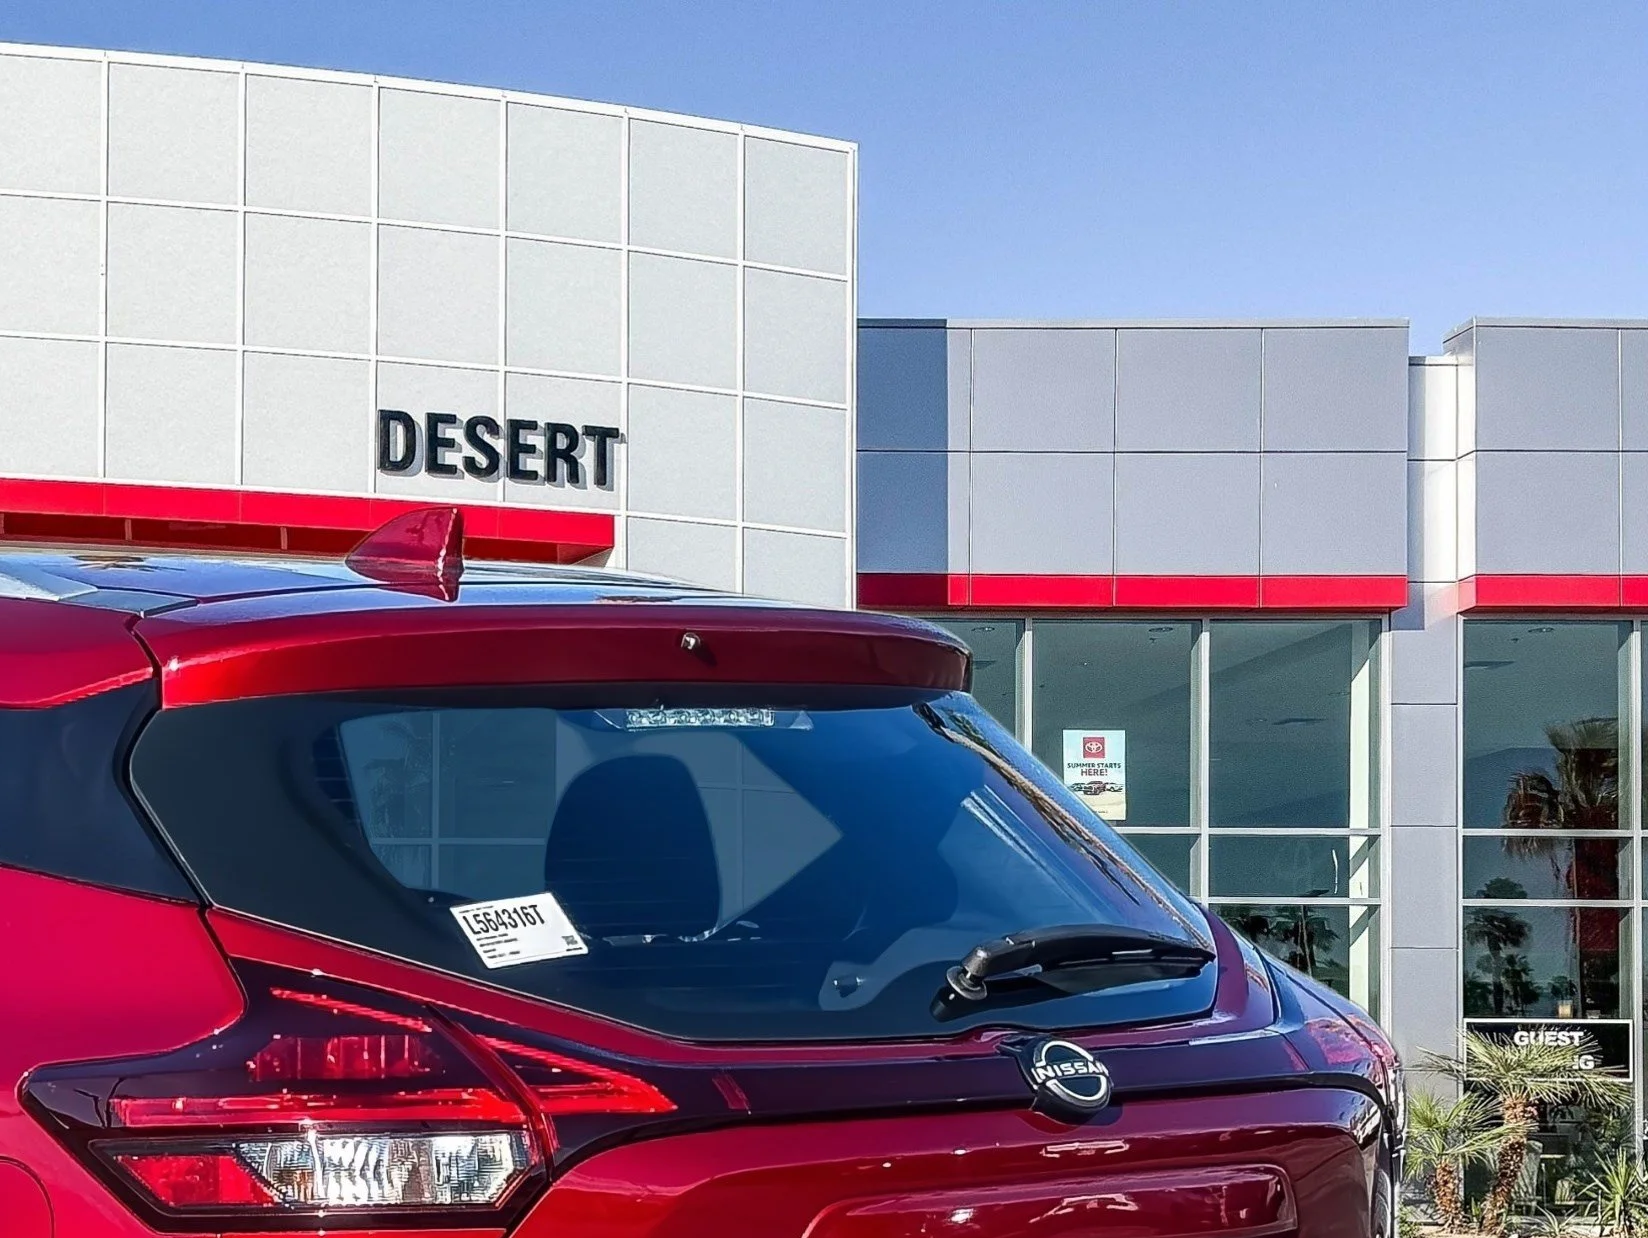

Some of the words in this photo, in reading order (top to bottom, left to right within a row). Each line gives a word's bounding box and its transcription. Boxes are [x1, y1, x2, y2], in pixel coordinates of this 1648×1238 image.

[377, 409, 620, 488] DESERT
[462, 904, 545, 935] L564316T
[1513, 1031, 1584, 1047] GUEST
[1032, 1060, 1109, 1083] NISSAN
